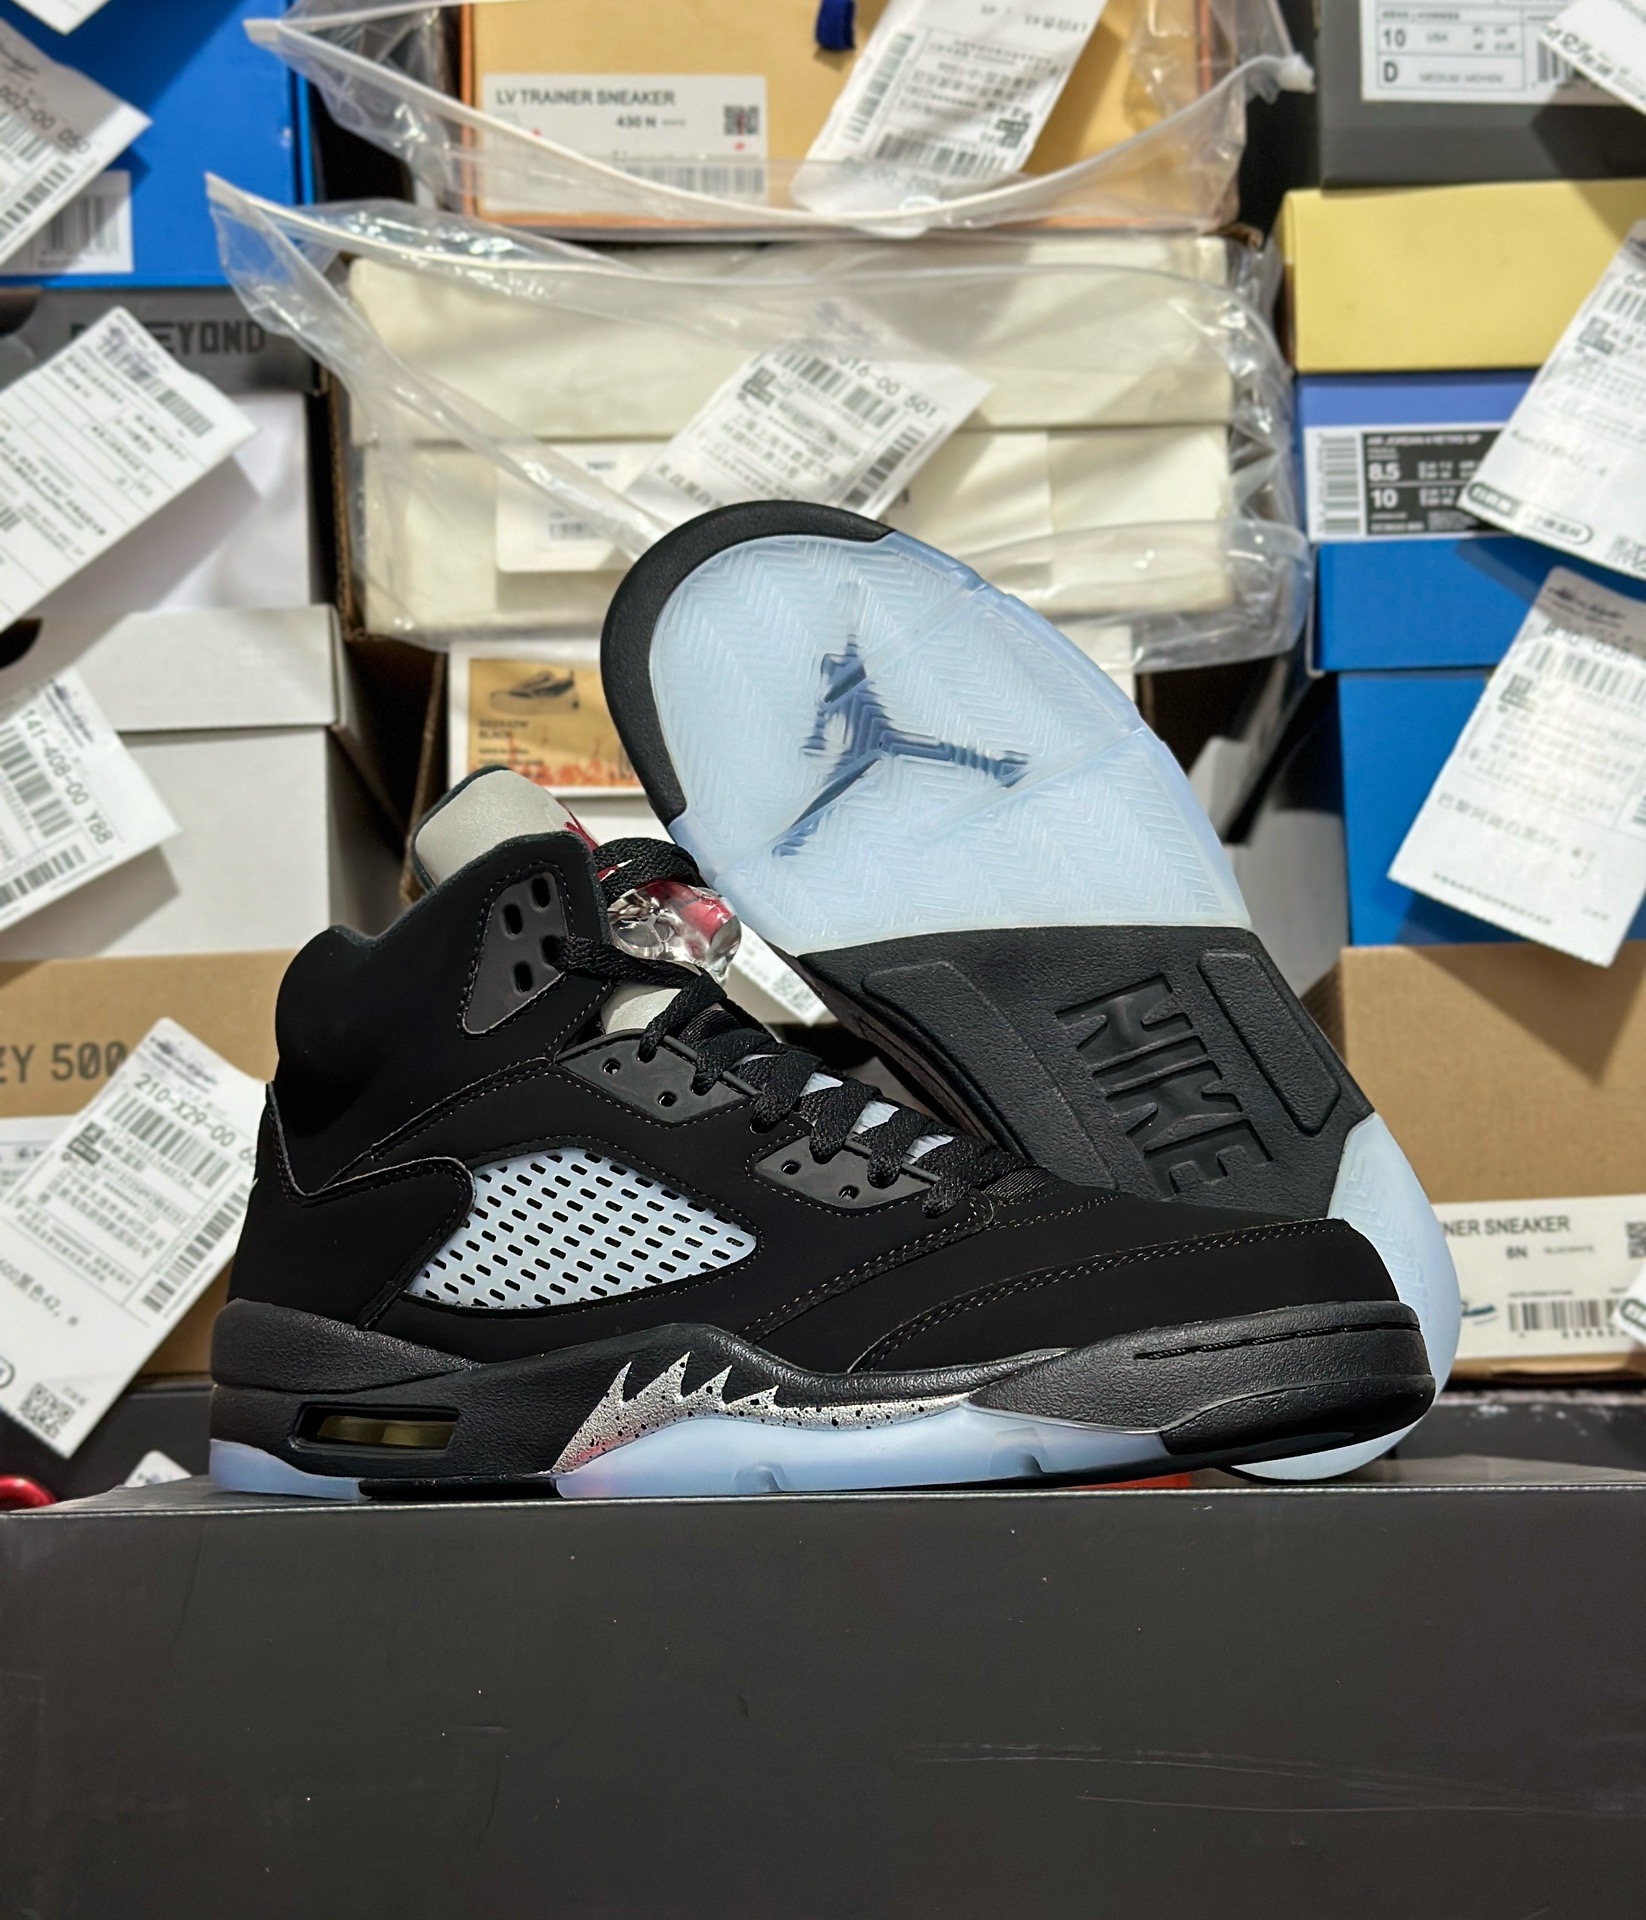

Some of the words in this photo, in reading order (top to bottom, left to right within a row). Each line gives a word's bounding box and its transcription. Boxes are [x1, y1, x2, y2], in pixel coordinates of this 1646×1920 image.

[1383, 28, 1406, 48] 10
[1384, 61, 1399, 83] D
[495, 89, 517, 105] LV
[520, 89, 593, 106] TRAINER
[596, 90, 676, 107] SNEAKER
[616, 115, 642, 129] 430
[645, 115, 657, 129] N
[1368, 461, 1402, 482] 8.5
[1370, 488, 1398, 509] 10
[51, 1040, 128, 1081] 500
[1054, 972, 1274, 1200] NIKE
[134, 1072, 236, 1148] 210-X29-00
[1484, 1215, 1571, 1236] SNEAKER
